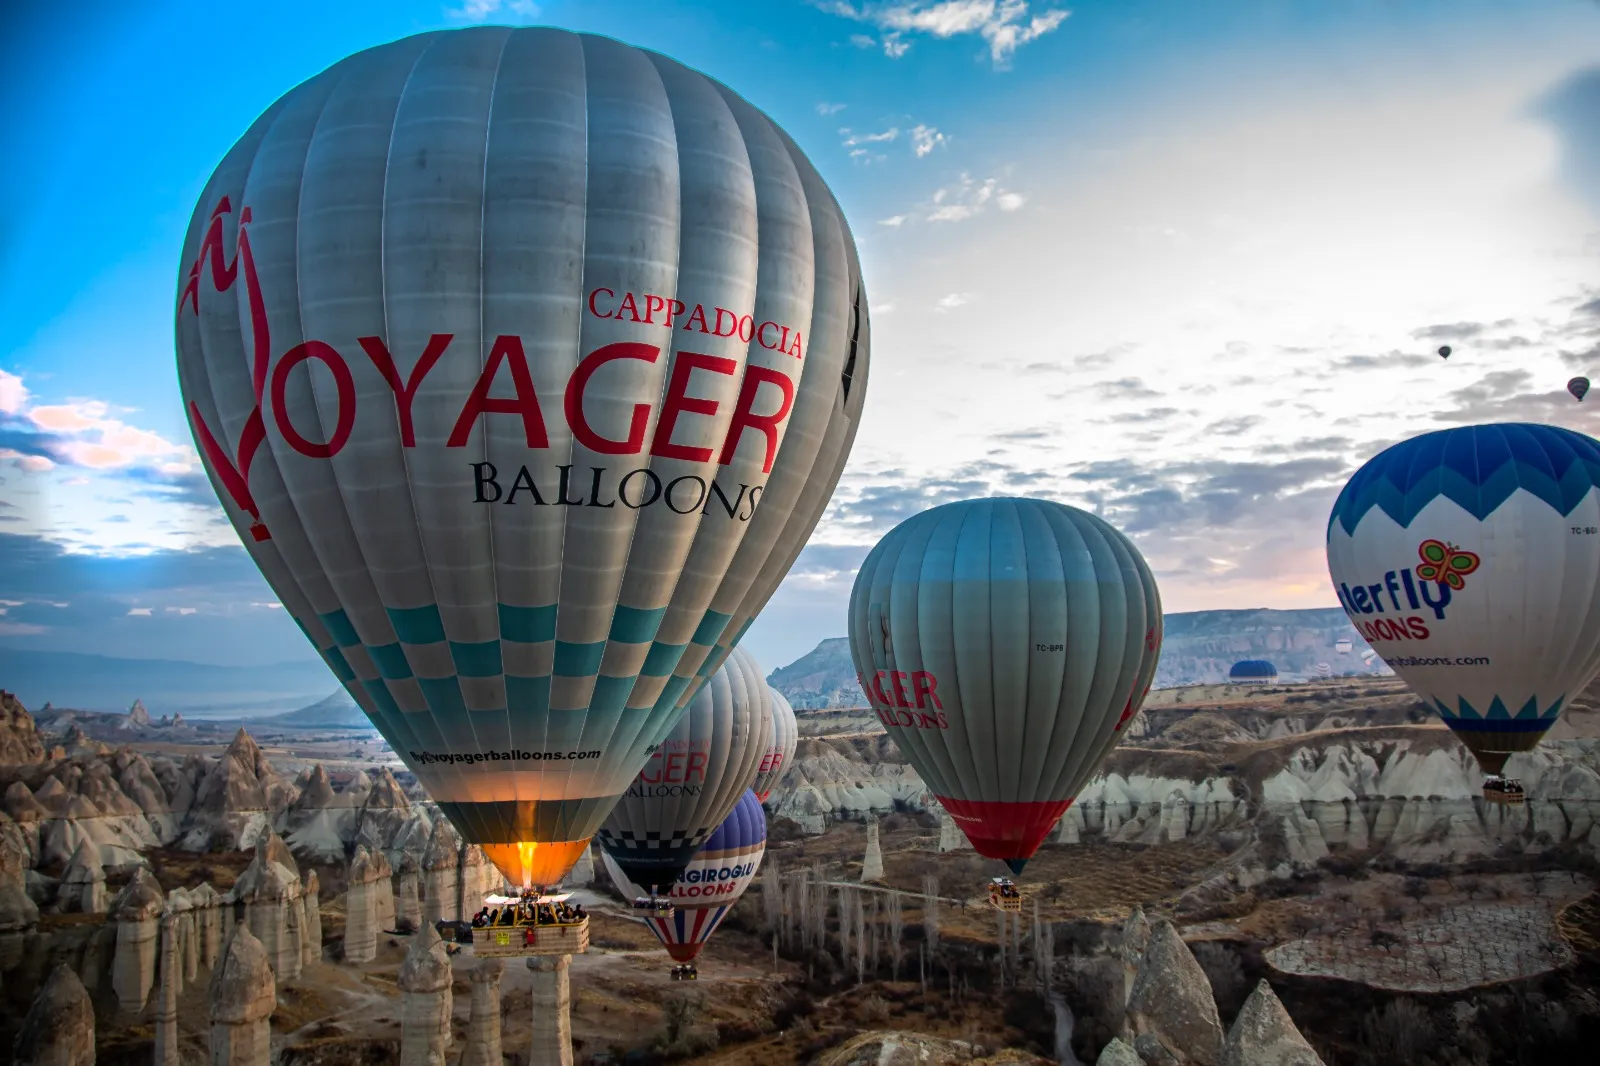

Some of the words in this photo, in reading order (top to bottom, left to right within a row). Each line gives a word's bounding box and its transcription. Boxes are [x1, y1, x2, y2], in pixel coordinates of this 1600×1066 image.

[588, 287, 803, 360] CAPPADOCIA
[469, 461, 763, 522] BALLOONS
[409, 750, 602, 765] fly@voyagerballoons.com
[633, 751, 708, 784] GER
